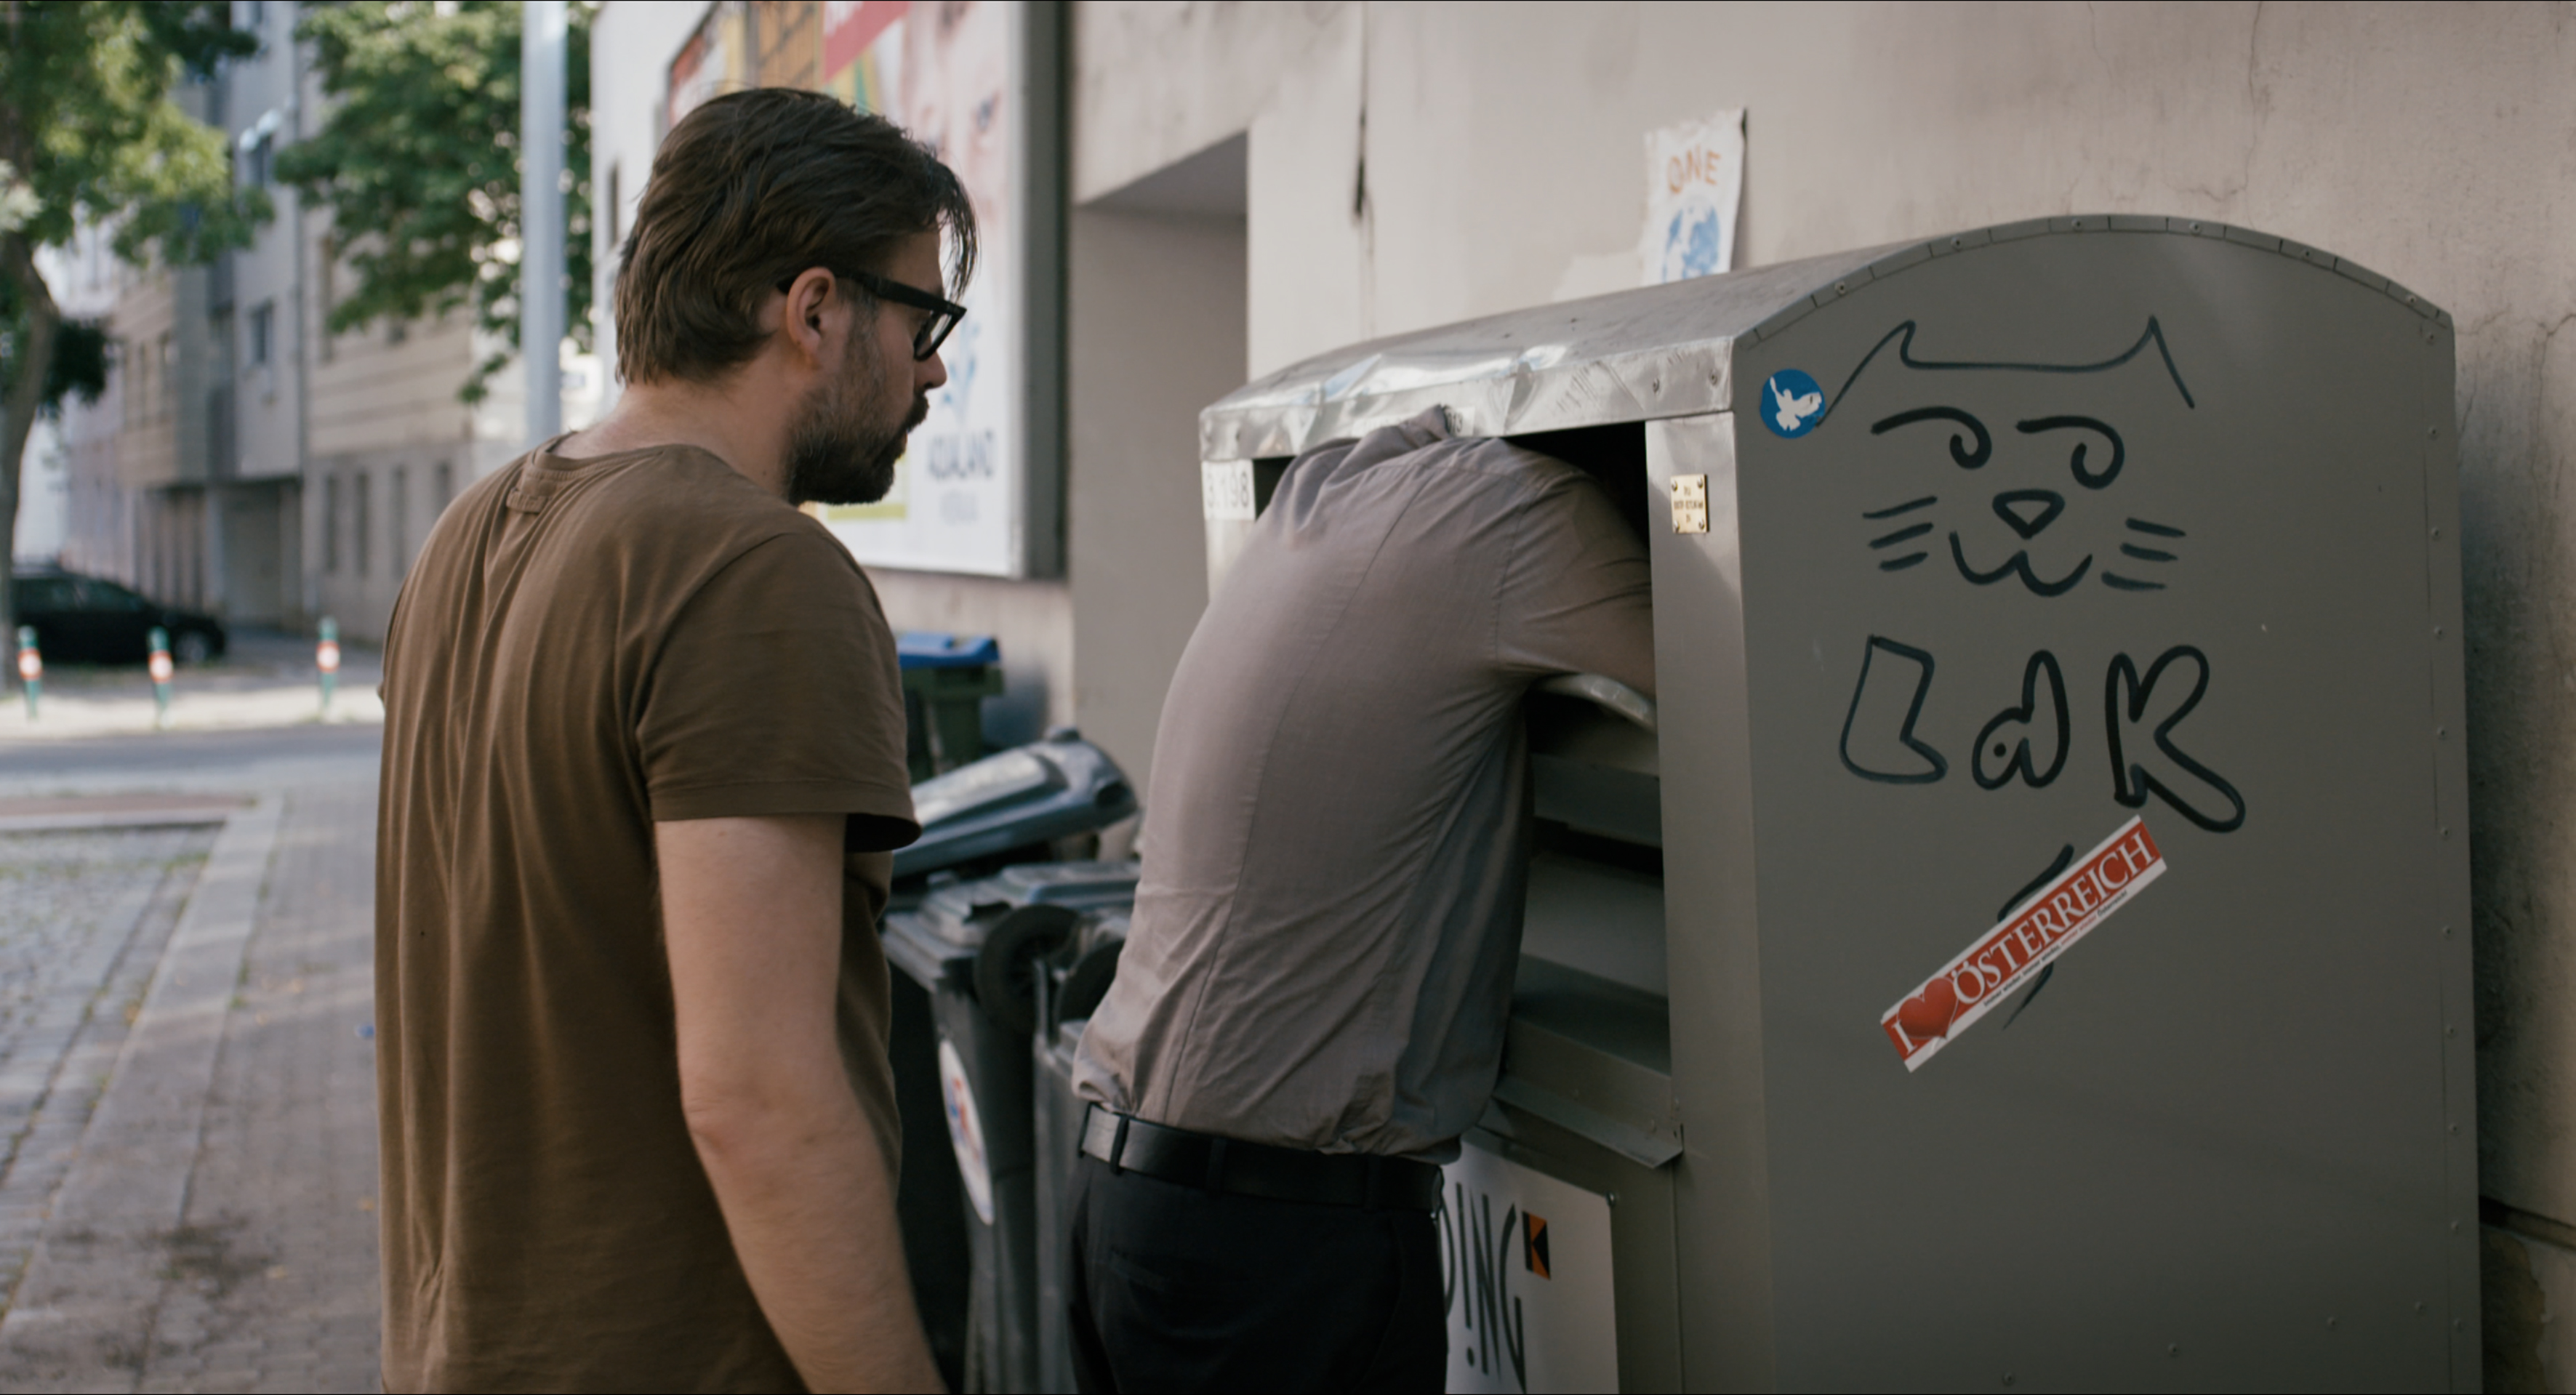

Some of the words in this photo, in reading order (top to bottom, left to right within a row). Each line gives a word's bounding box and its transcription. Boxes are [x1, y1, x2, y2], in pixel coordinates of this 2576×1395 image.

[1668, 145, 1721, 194] ONE
[1891, 1019, 1918, 1055] I
[1951, 831, 2155, 1005] ÖSTERREICH
